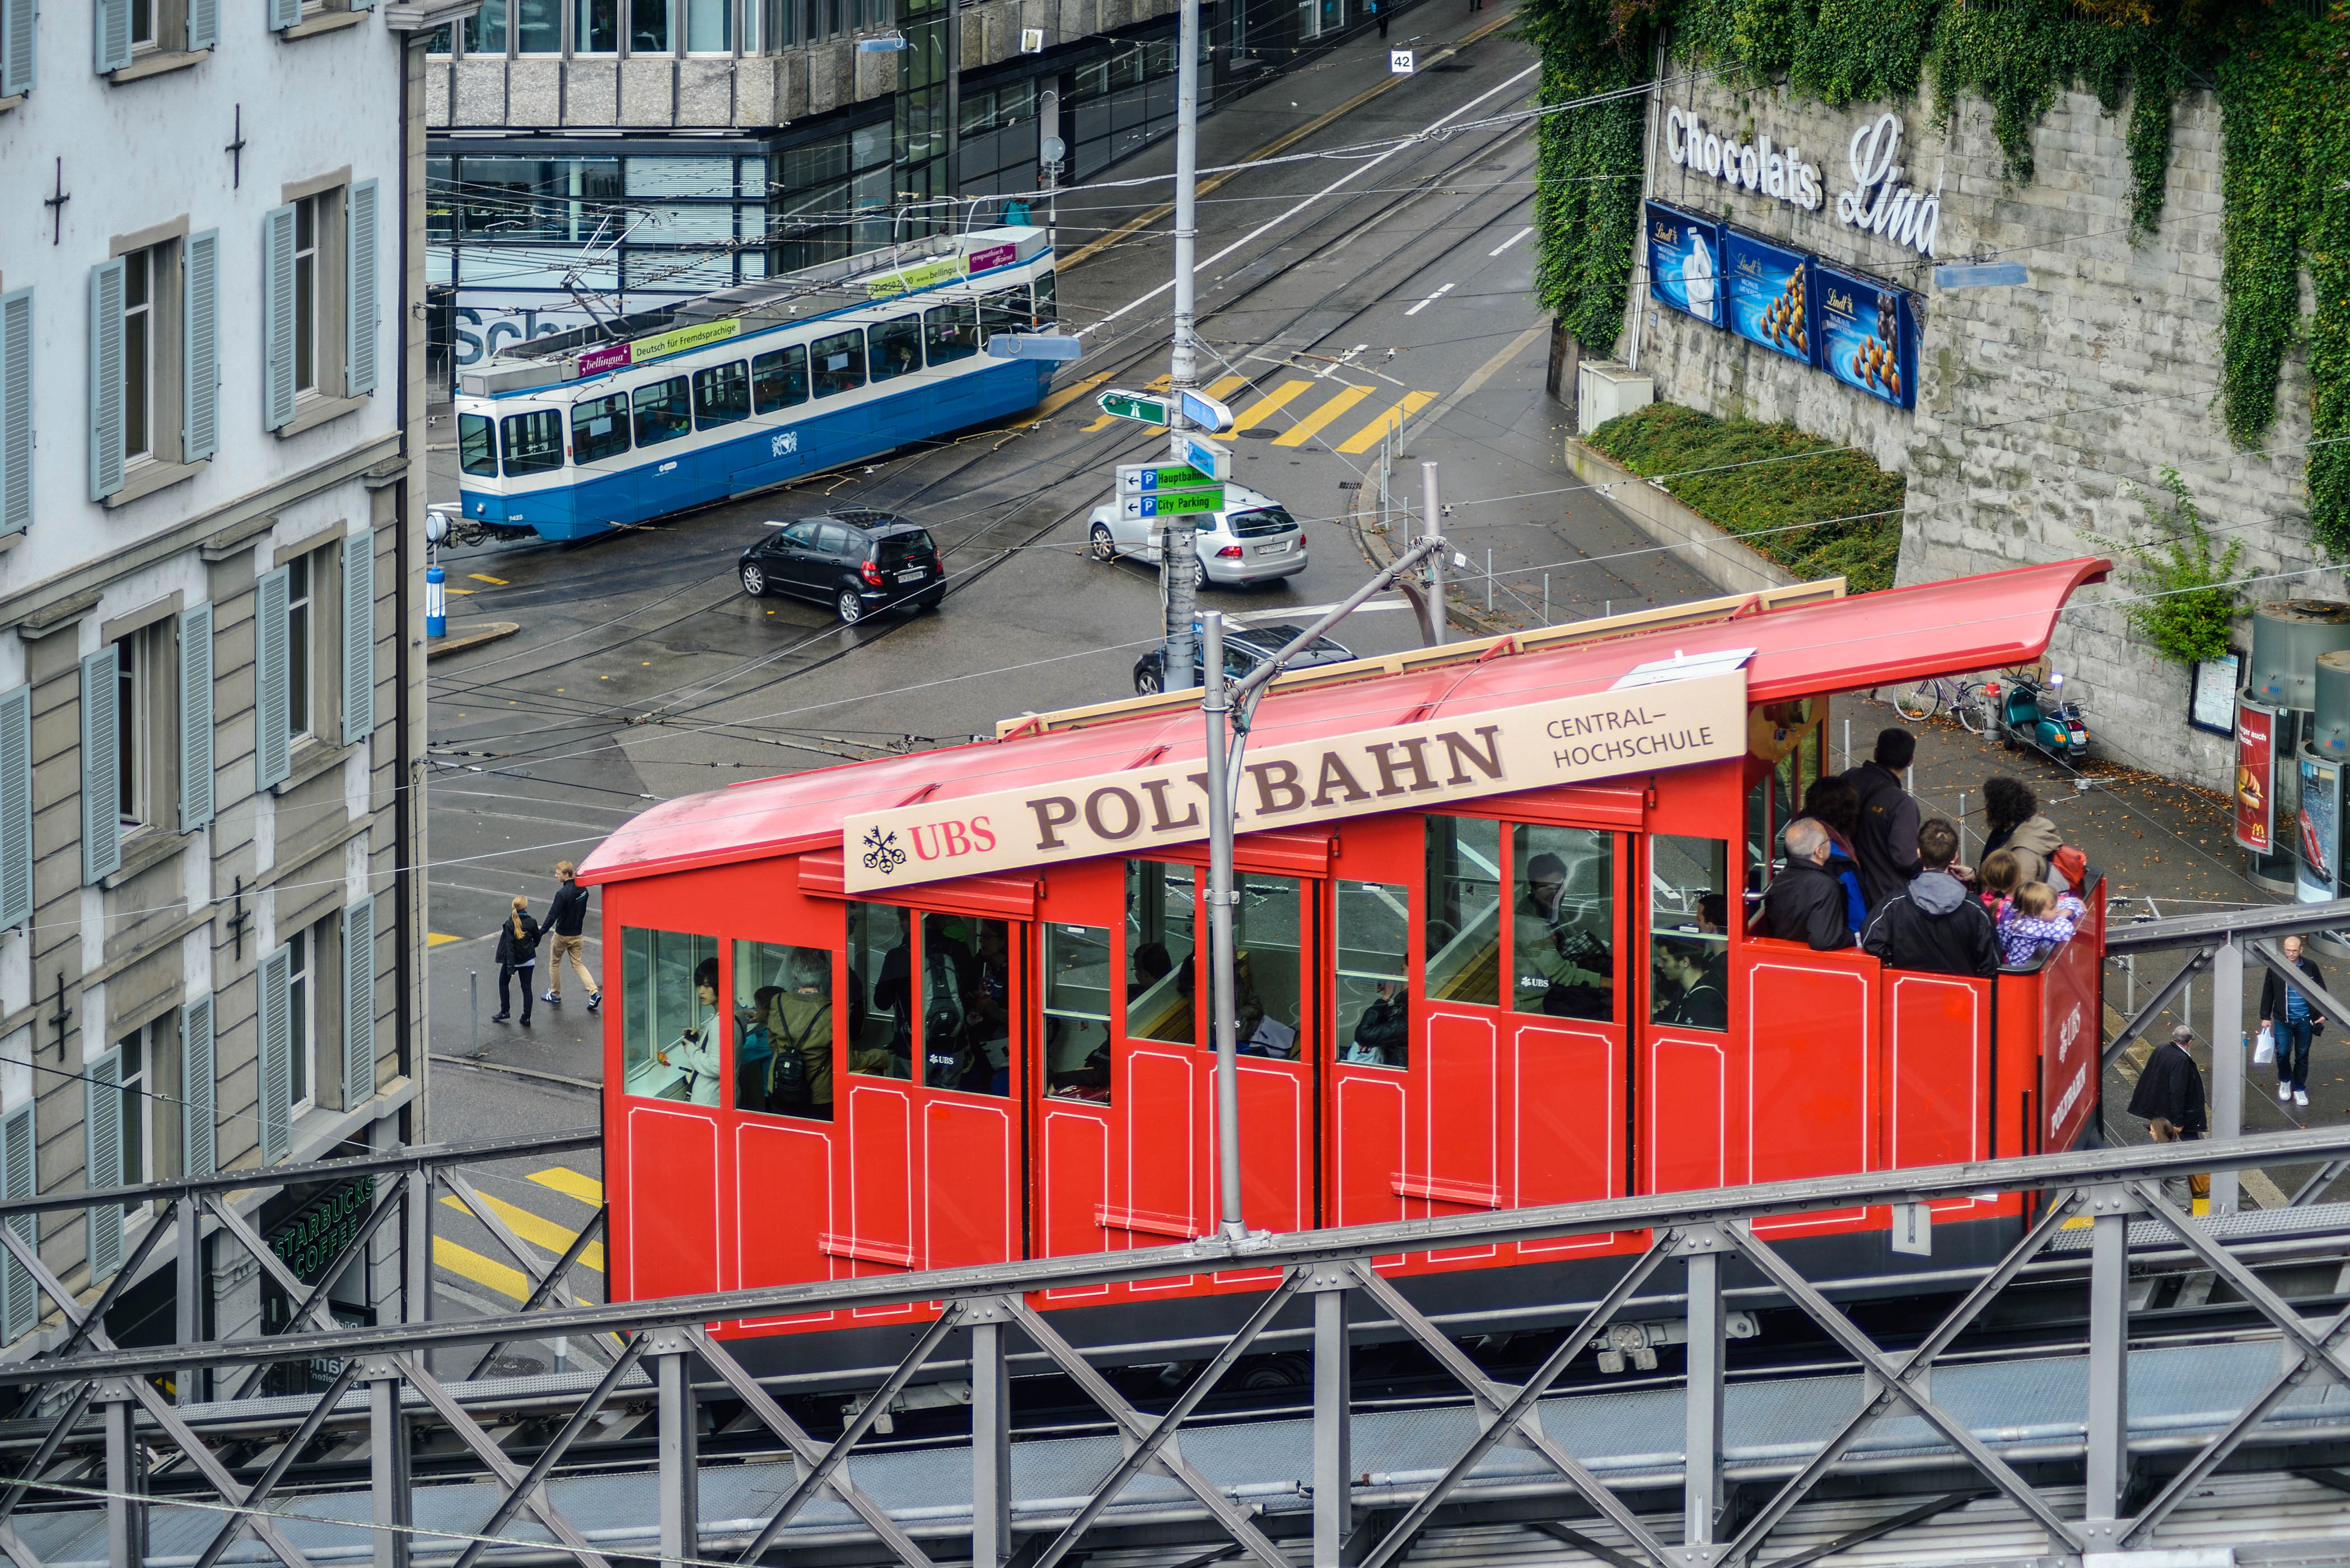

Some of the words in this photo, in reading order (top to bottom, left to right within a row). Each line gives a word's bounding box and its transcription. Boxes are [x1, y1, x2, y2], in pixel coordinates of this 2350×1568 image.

[1394, 57, 1410, 67] 42
[1667, 105, 1823, 210] Chocolats
[1655, 222, 1673, 242] Lindt
[972, 246, 1004, 264] sympathisch
[992, 254, 1013, 266] effizient
[1736, 252, 1756, 274] Lindt
[1826, 288, 1847, 311] Lindt
[636, 341, 666, 357] Deutsch
[667, 338, 679, 348] für
[680, 324, 736, 346] Fremdsprachige
[1157, 469, 1211, 485] Hauptbahn
[1157, 499, 1175, 512] City
[1178, 497, 1210, 509] Parking
[508, 514, 523, 522] 2423
[2251, 731, 2267, 742] auch
[1553, 726, 1714, 770] HOCHSCHULE
[908, 816, 997, 861] UBS
[1531, 978, 1549, 988] UBS
[938, 1056, 954, 1065] UBS
[274, 1173, 375, 1262] STARBUCKS
[294, 1214, 357, 1281] COFFEE
